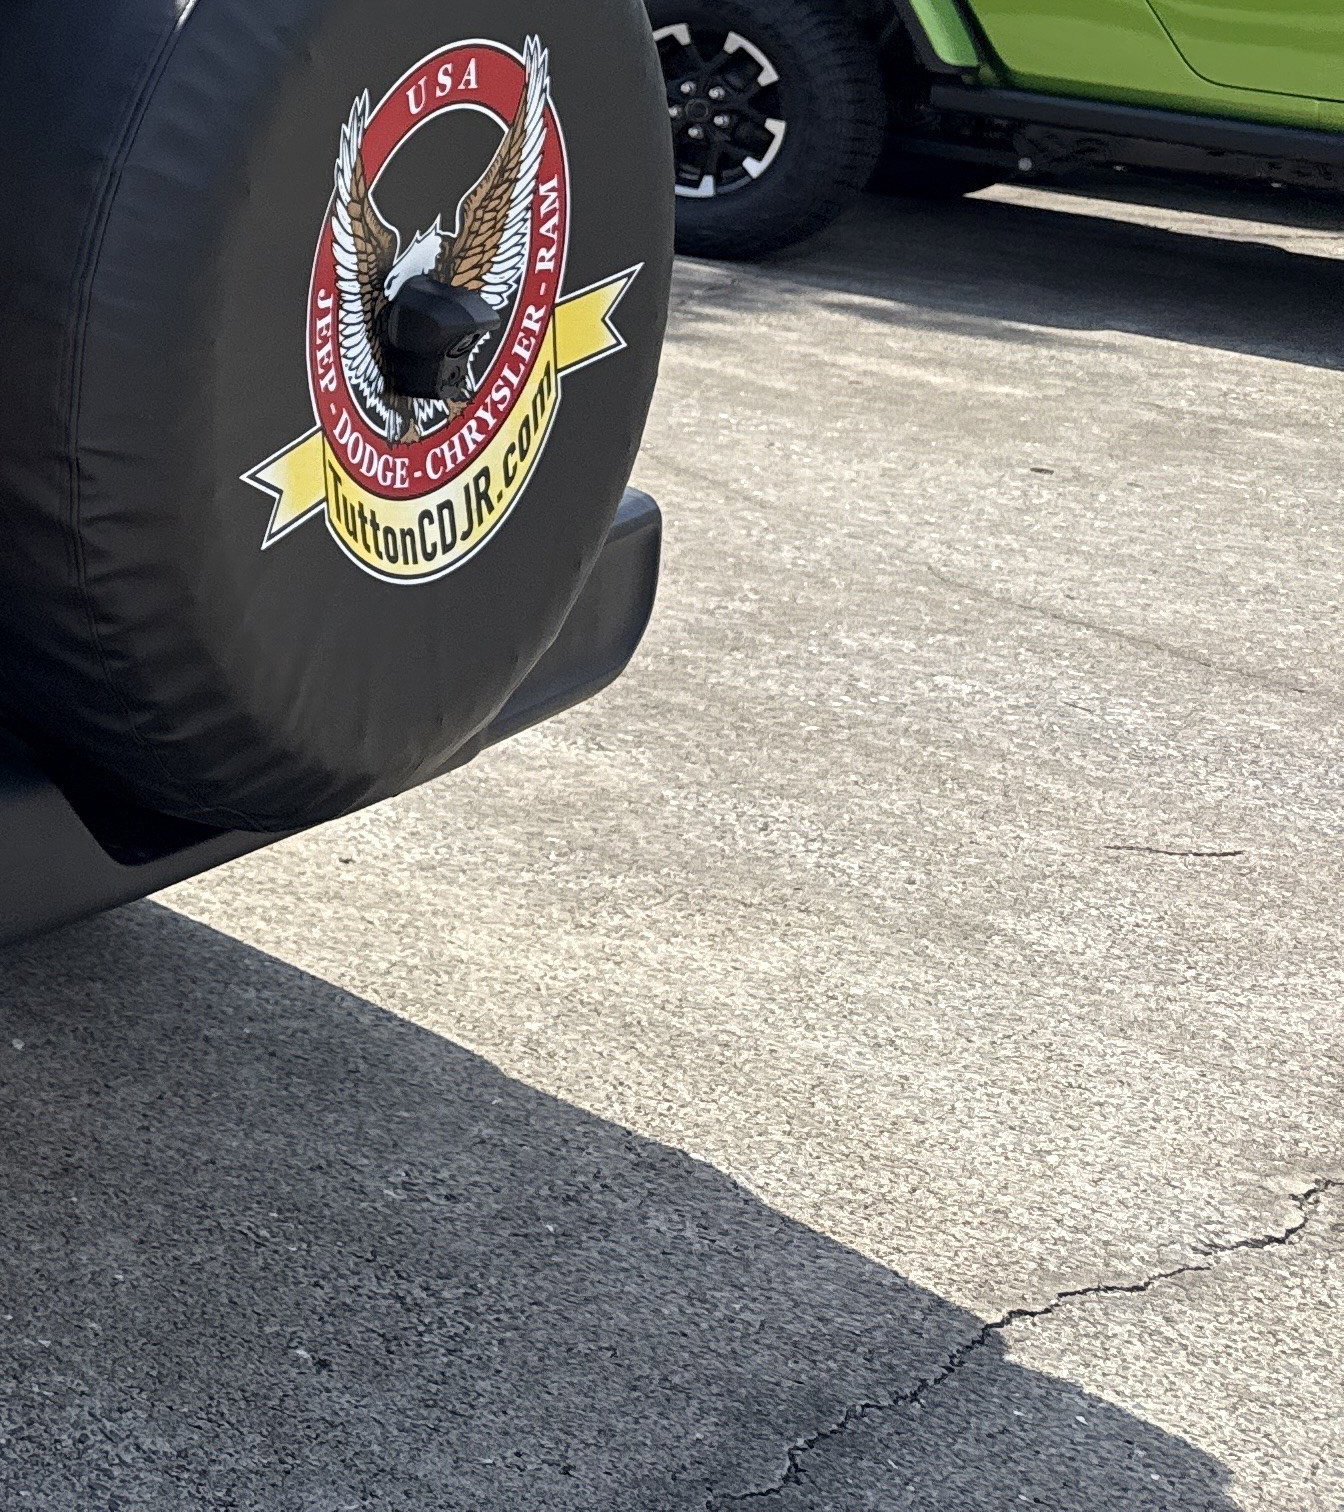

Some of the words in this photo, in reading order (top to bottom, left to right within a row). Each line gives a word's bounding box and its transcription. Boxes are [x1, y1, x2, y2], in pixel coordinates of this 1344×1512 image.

[406, 57, 479, 115] USA
[313, 288, 339, 394] JEEP
[333, 414, 411, 490] DODGE
[426, 303, 548, 480] CHRYSLER
[534, 174, 561, 279] RAM
[328, 361, 554, 565] TuttonCDJR.com
